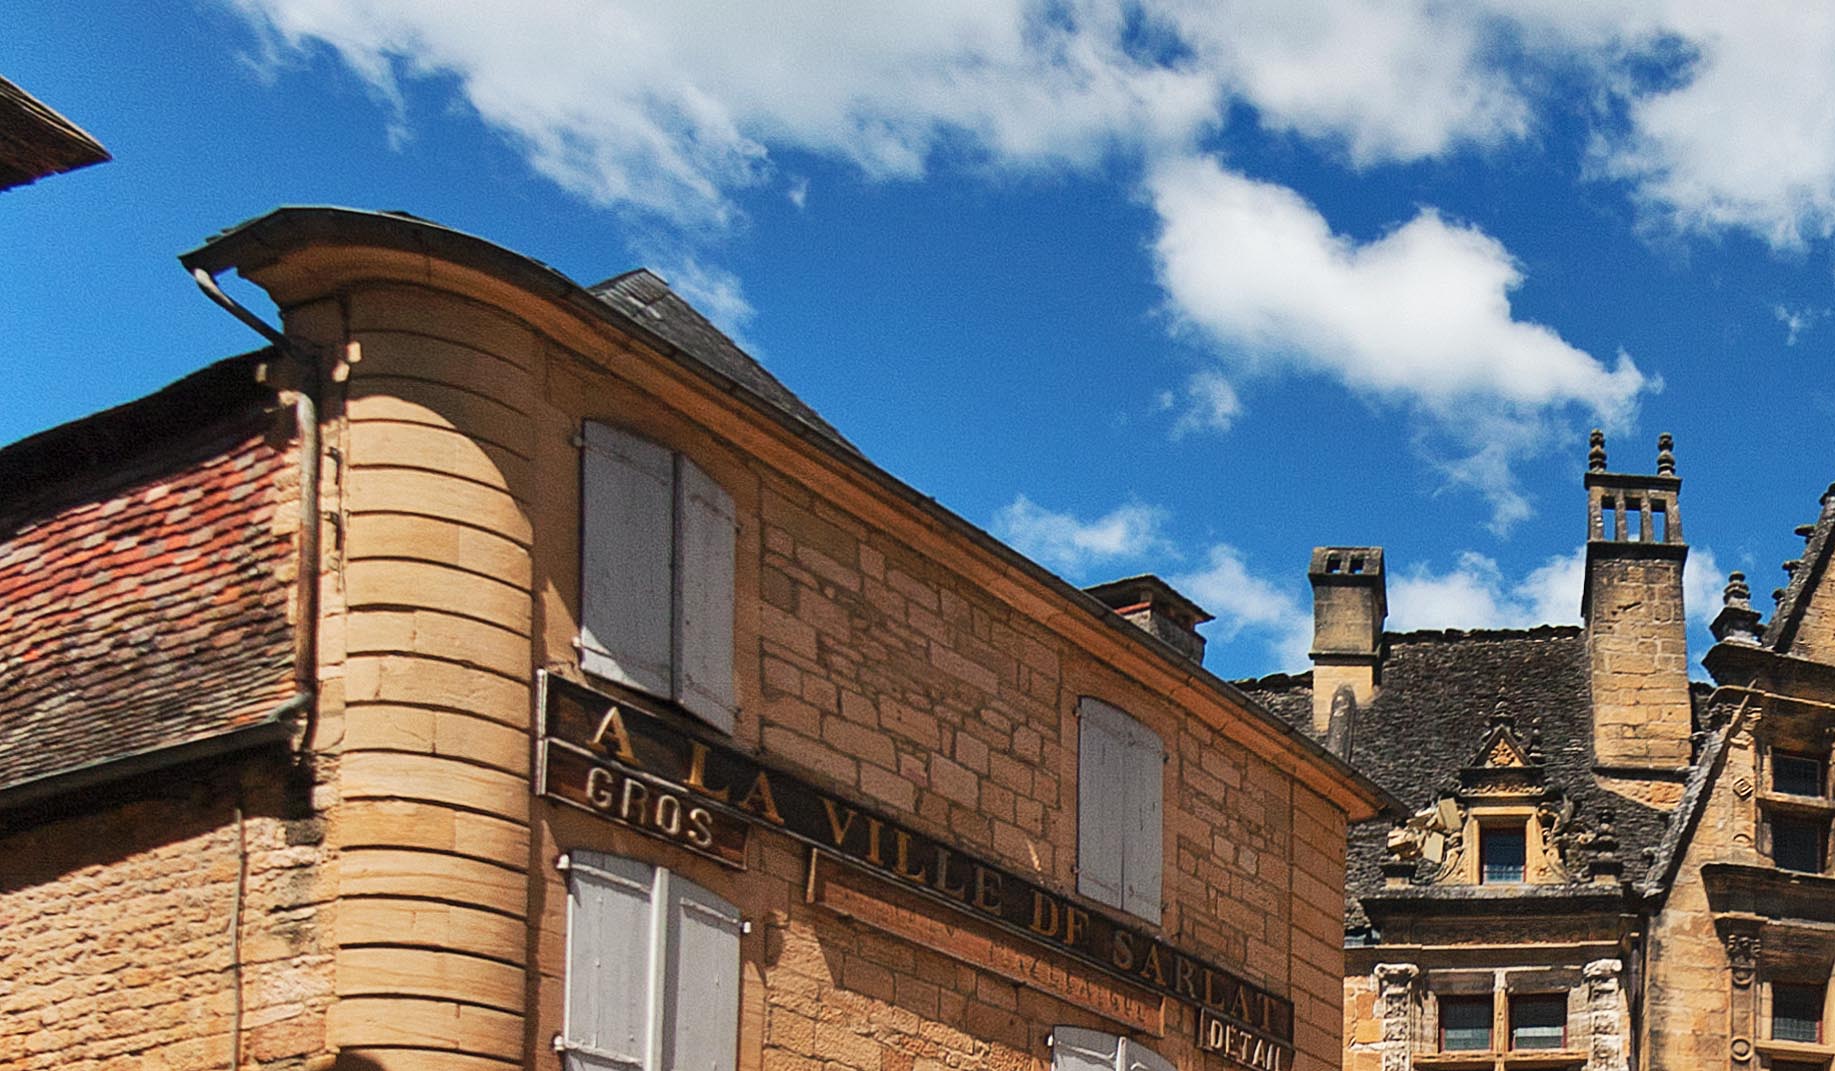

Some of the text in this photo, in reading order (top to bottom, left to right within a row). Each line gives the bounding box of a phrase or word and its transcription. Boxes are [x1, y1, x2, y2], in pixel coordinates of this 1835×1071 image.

[586, 766, 714, 848] GROS
[586, 706, 639, 766] A
[683, 738, 785, 825] LA
[818, 796, 1003, 917] VILLE
[1112, 930, 1280, 1034] SARLAT
